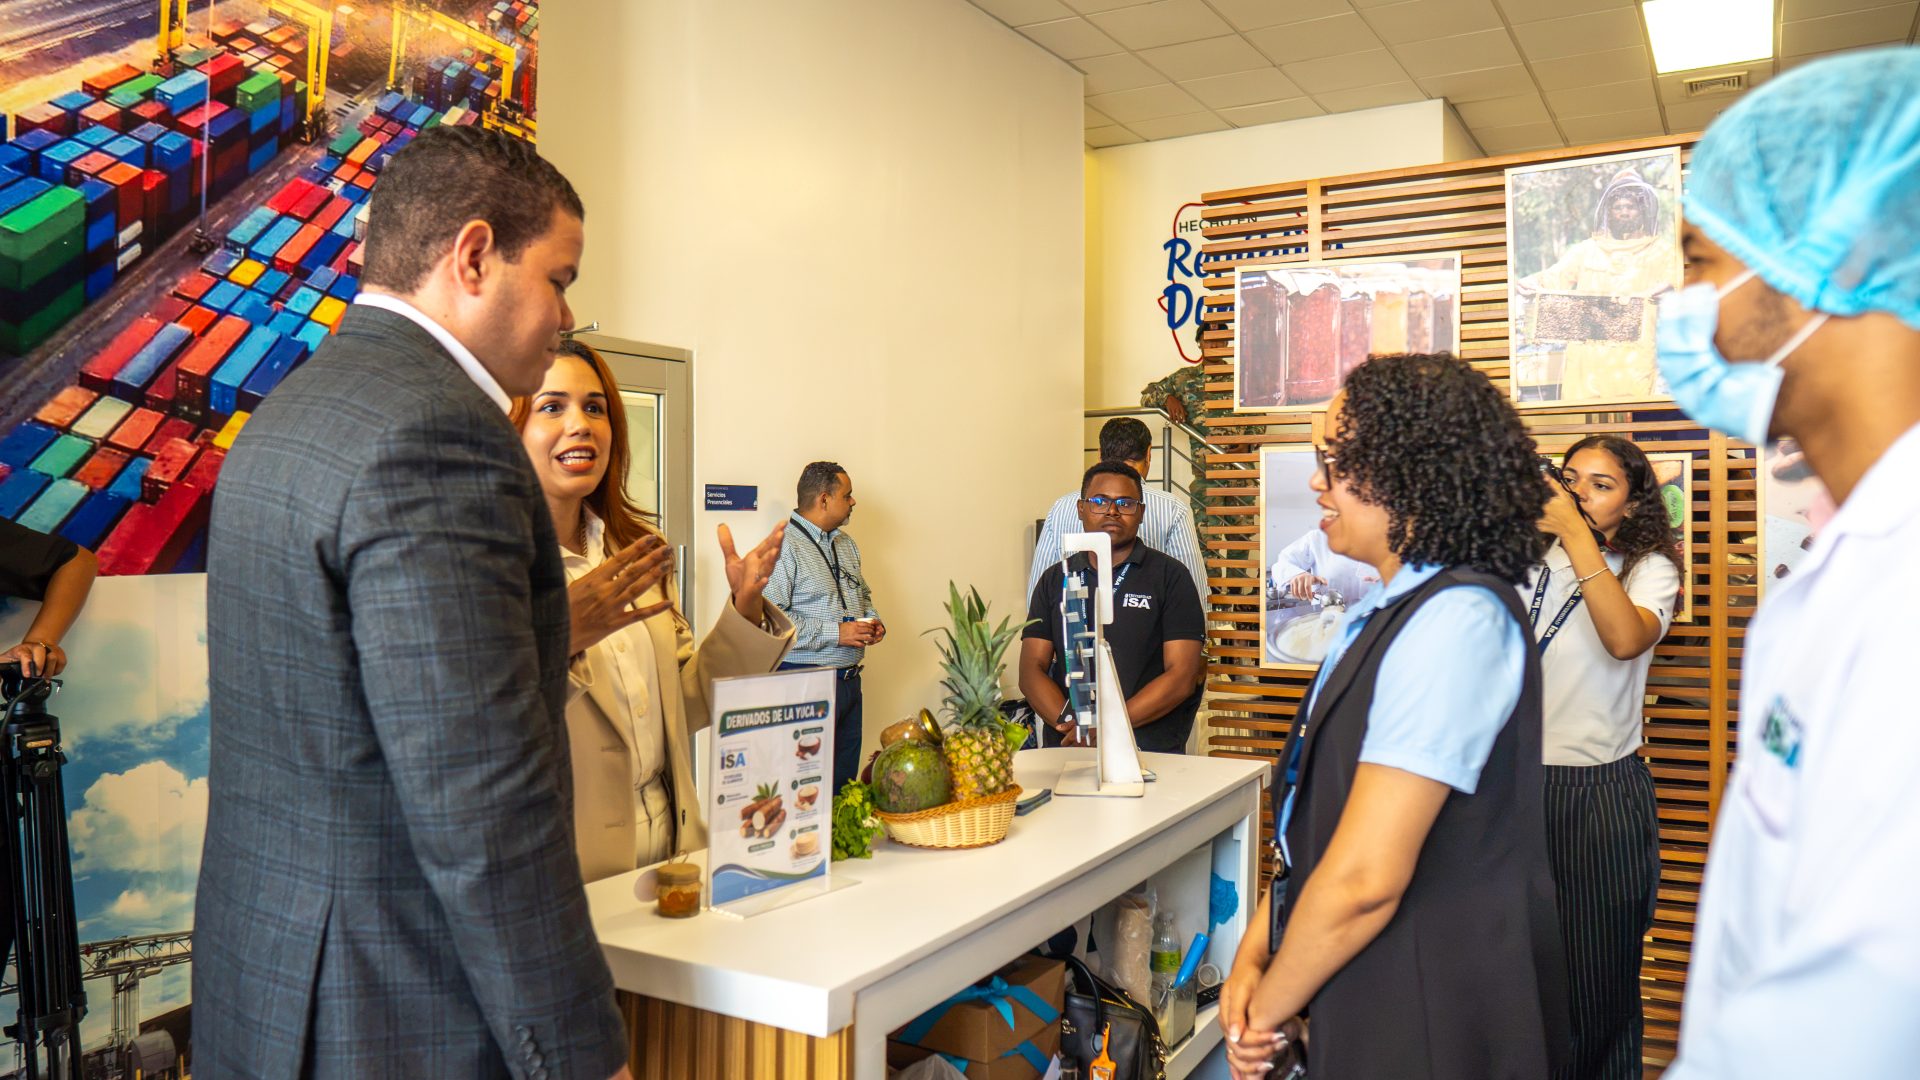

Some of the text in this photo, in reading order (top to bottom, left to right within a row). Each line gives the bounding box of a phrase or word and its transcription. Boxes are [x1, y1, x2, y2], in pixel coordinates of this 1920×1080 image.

[726, 704, 815, 729] DERIVADOS DE LA YUCA
